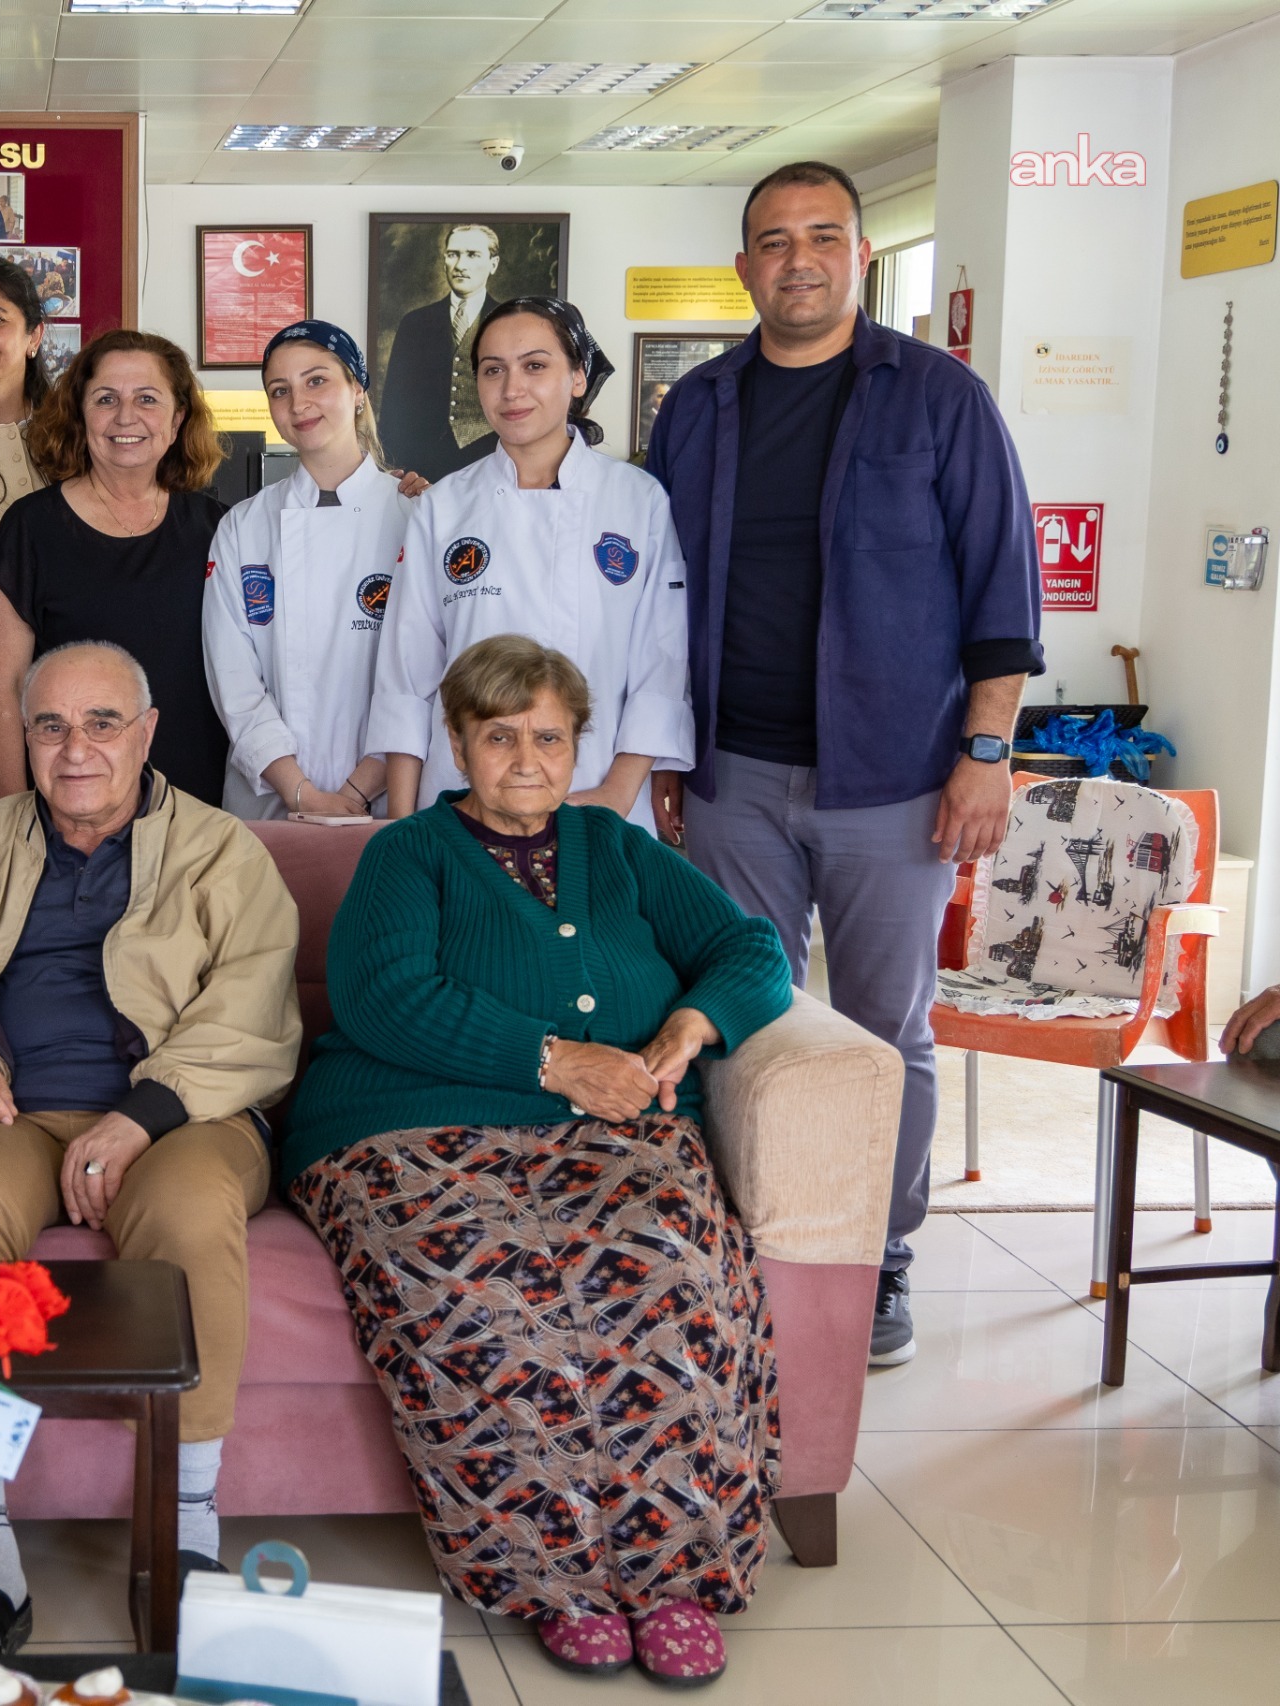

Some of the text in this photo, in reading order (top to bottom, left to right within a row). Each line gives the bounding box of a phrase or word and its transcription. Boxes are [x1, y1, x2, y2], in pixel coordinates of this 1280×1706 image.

[1055, 352, 1100, 361] İDAREDEN
[1039, 365, 1114, 374] İZİNSİZ GÖRÜNTÜ
[1033, 377, 1065, 385] ALMAK
[1046, 579, 1081, 588] YANGIN
